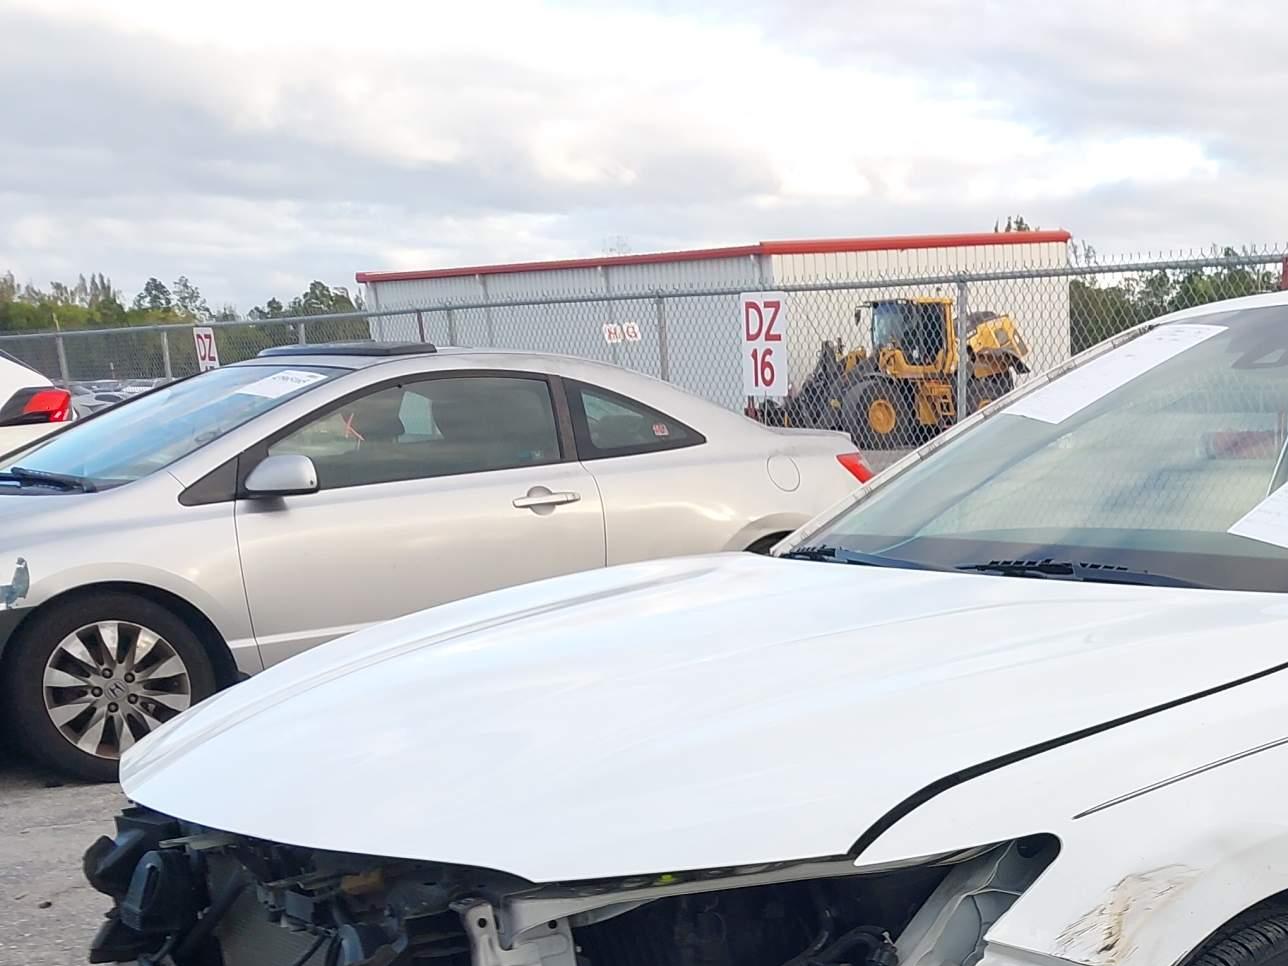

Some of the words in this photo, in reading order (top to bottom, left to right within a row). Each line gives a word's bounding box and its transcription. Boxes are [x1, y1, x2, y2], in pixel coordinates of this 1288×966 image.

[744, 301, 782, 342] DZ
[196, 333, 216, 361] DZ
[751, 348, 775, 387] 16
